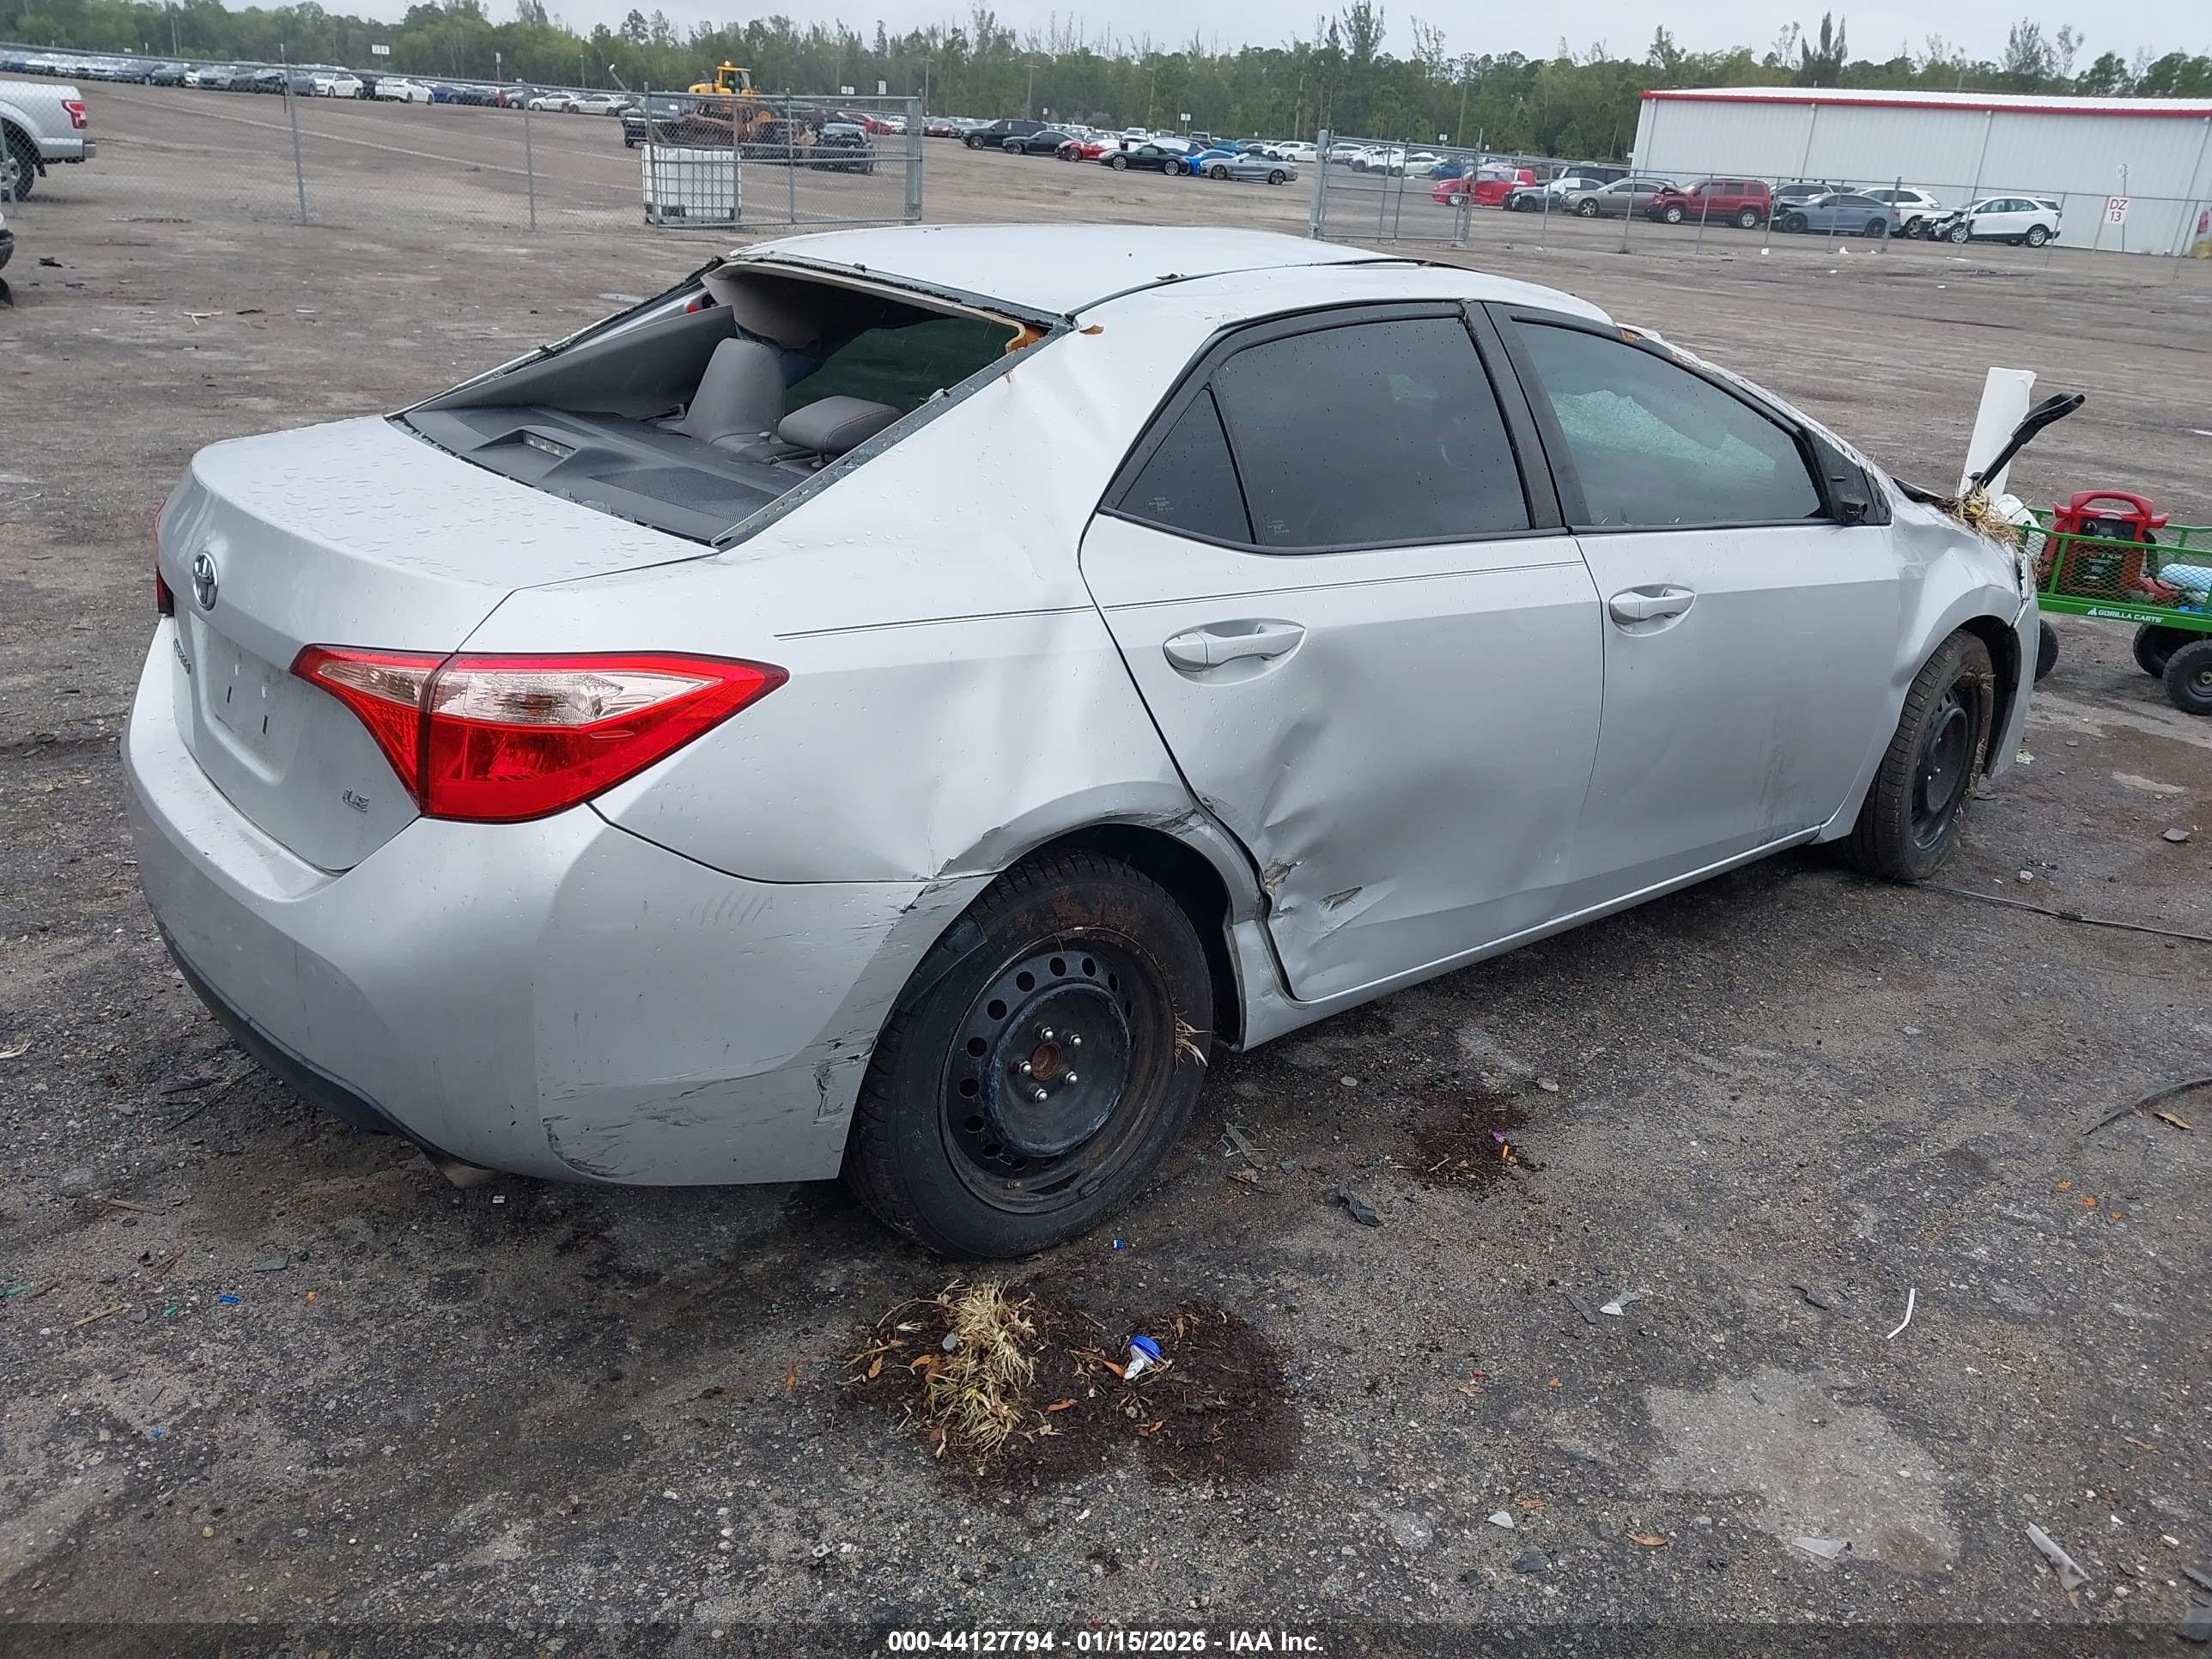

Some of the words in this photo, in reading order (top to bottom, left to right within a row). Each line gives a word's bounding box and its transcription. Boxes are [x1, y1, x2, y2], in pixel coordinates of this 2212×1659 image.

[2110, 199, 2128, 210] DZ
[2110, 211, 2122, 222] 13
[2098, 610, 2132, 619] GORILLA
[2134, 614, 2162, 623] CARTS
[342, 788, 369, 812] LE
